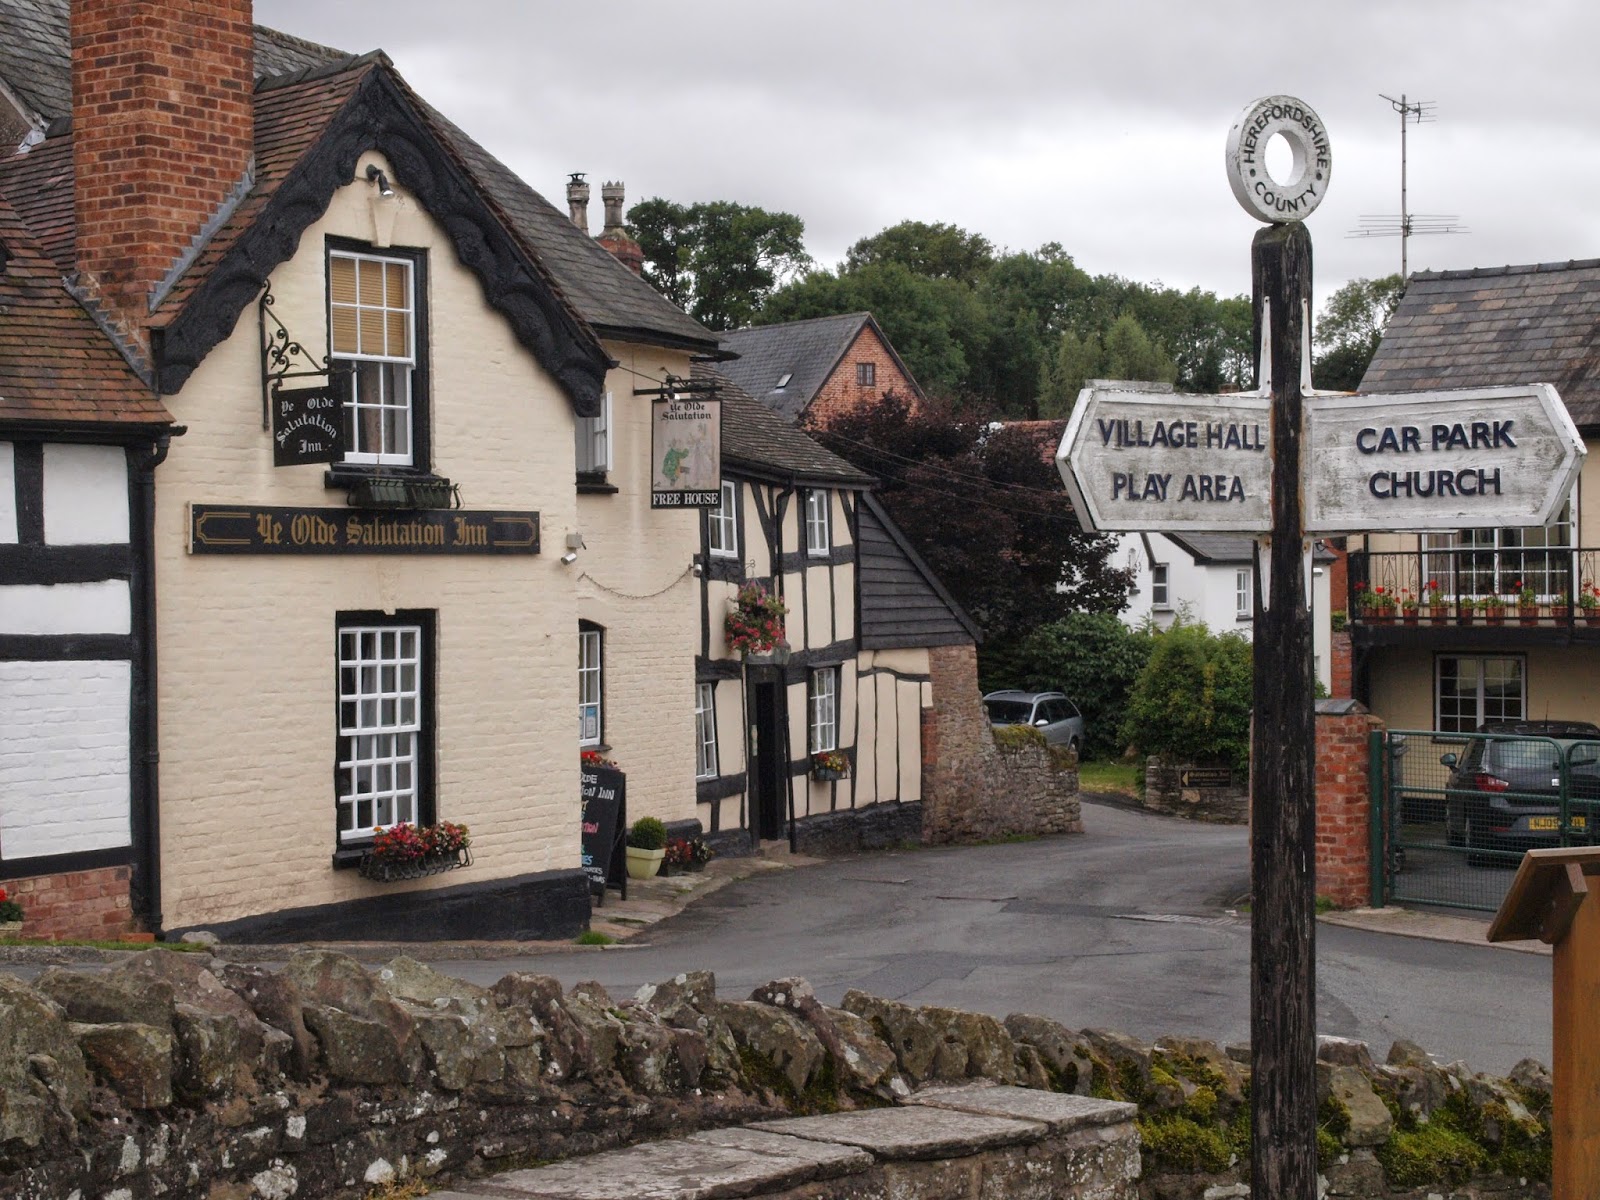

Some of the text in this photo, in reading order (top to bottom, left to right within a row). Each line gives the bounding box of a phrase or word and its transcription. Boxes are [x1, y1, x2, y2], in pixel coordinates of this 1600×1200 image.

[1243, 104, 1328, 169] HEREFORDSHIRE
[1254, 181, 1317, 213] COUNTY
[281, 397, 334, 417] Ye Olde
[660, 411, 712, 420] Salutation
[670, 402, 705, 413] Ye Olde
[276, 412, 337, 449] Salutation
[298, 439, 323, 454] Inn
[1097, 418, 1266, 451] VILLAGE HALL
[1355, 419, 1518, 455] CAR PARK
[653, 492, 719, 505] FREE HOUSE
[1111, 472, 1246, 502] PLAY AREA
[1368, 467, 1504, 499] CHURCH
[256, 513, 488, 546] Ye Olde Salutation Inn
